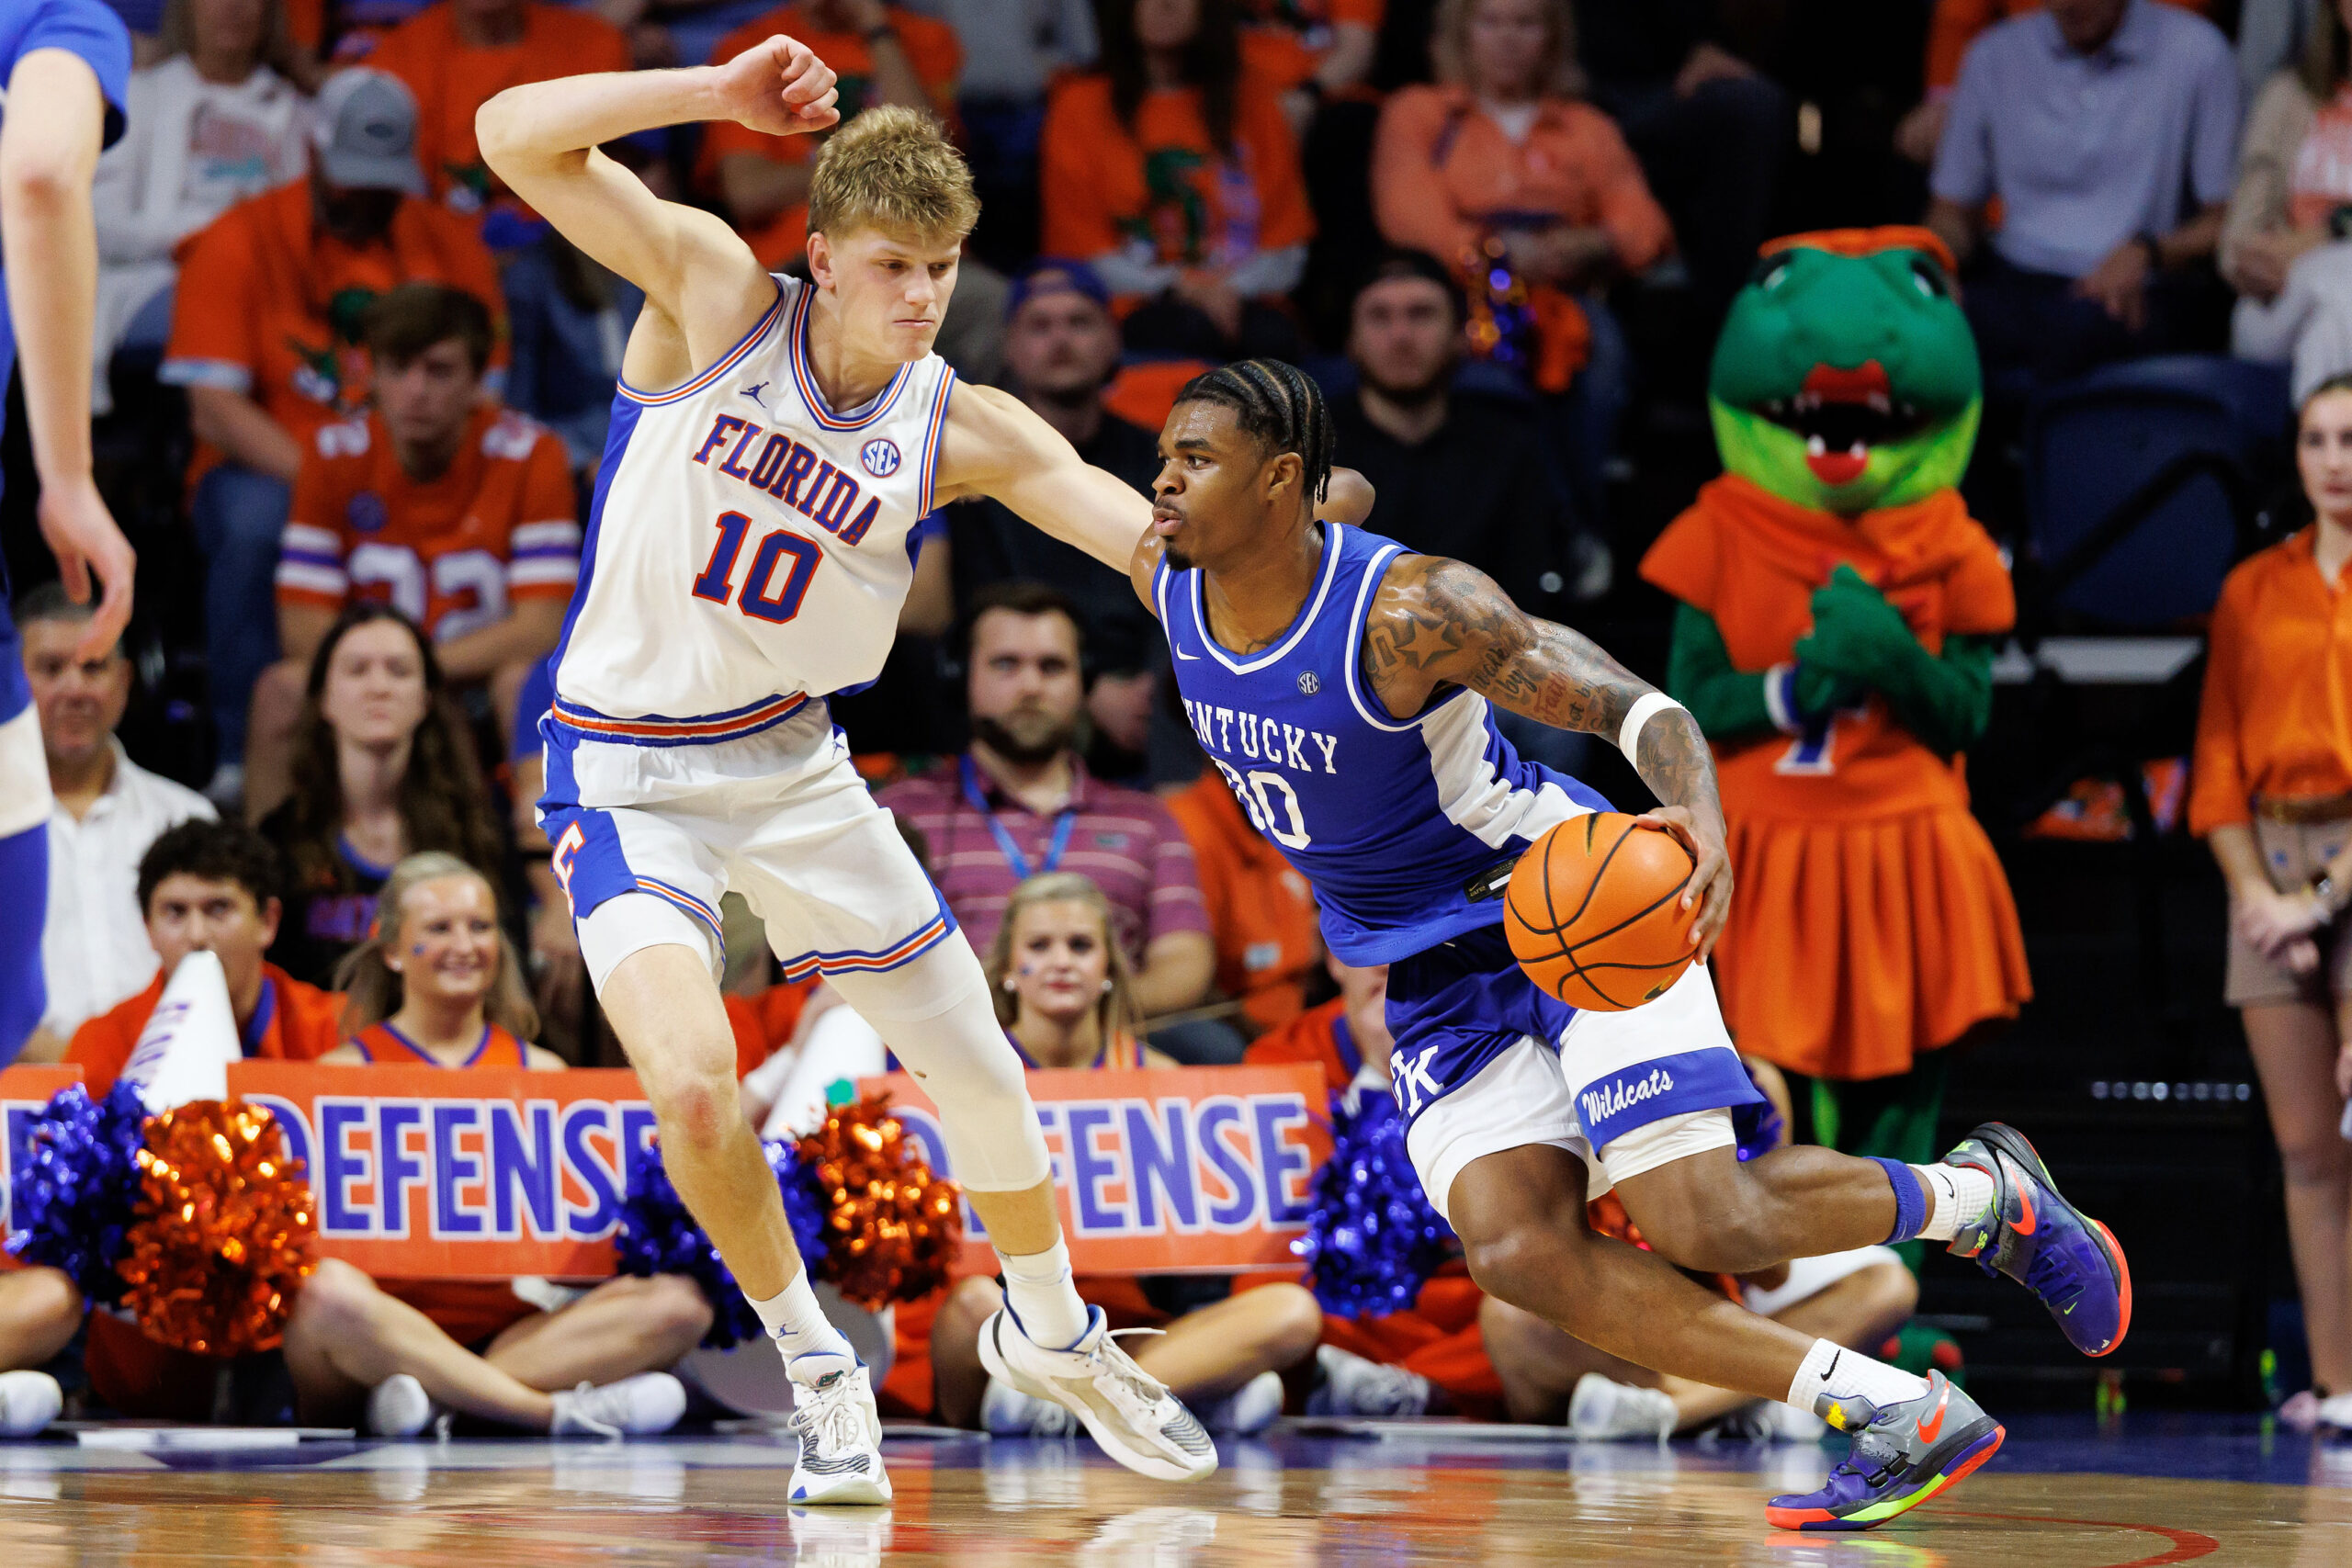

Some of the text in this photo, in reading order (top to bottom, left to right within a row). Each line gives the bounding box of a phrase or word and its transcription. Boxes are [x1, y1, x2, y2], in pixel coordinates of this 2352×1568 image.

[693, 412, 882, 547] FLORIDA
[863, 440, 899, 476] SEC
[691, 510, 824, 626] 10
[1297, 671, 1320, 695] SEC
[1182, 695, 1338, 774] ENTUCKY
[1582, 1068, 1674, 1126] Wildcats
[888, 1092, 1314, 1243] ENSE
